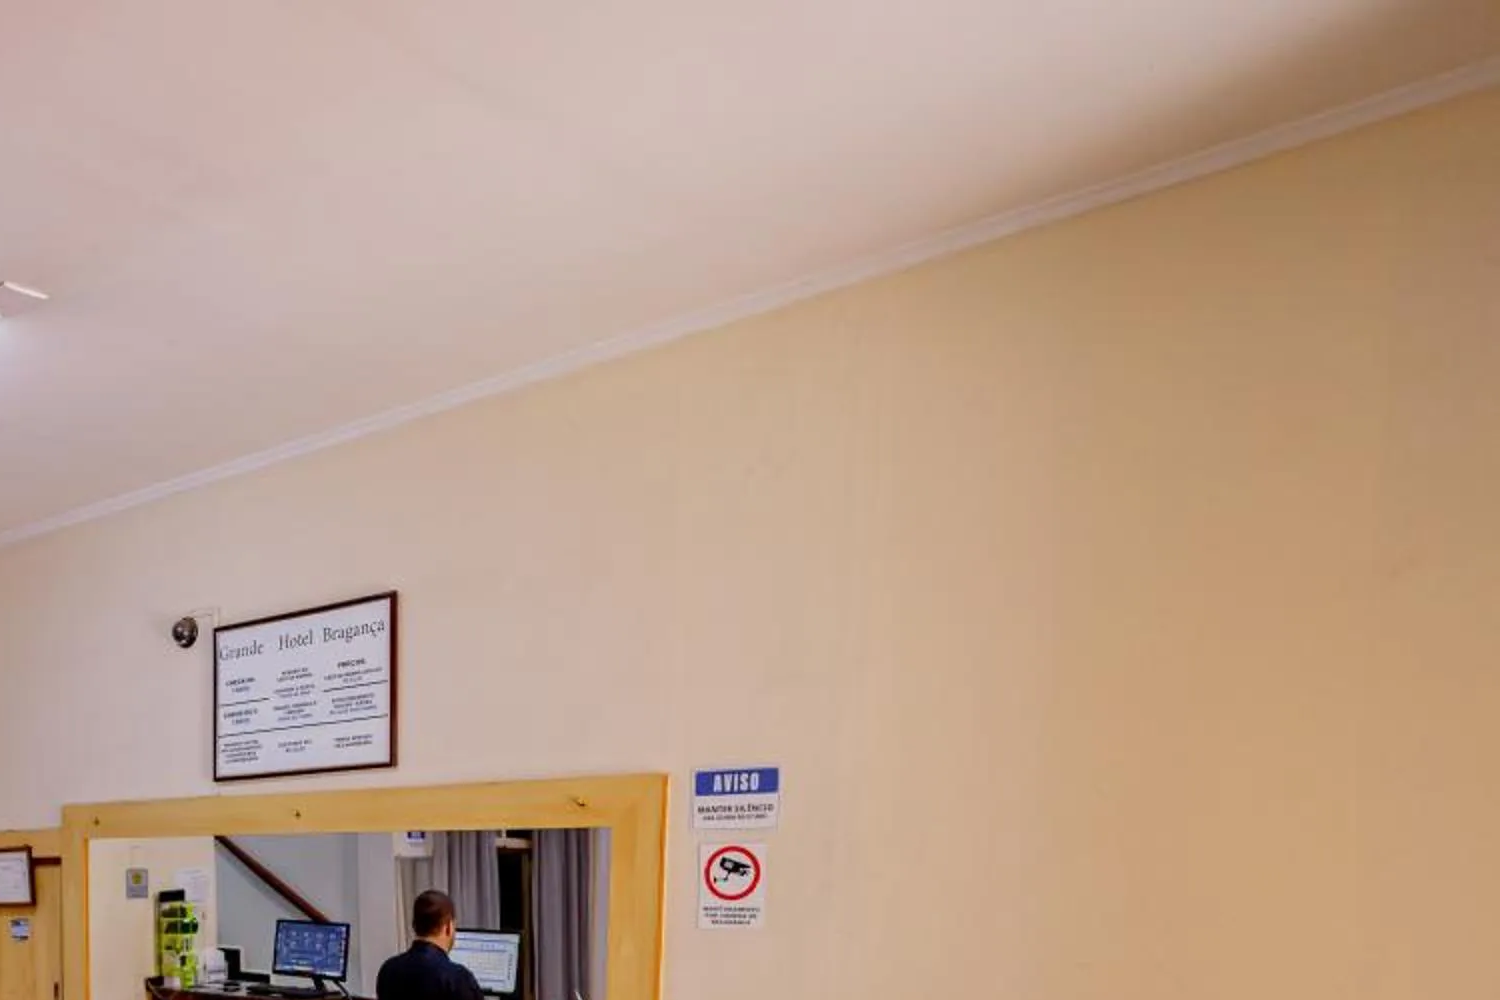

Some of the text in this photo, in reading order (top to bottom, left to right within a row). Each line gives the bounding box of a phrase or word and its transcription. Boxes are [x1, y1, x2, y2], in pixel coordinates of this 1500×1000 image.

[219, 619, 386, 661] Grande Hotel Bragança
[713, 772, 760, 793] AVISO
